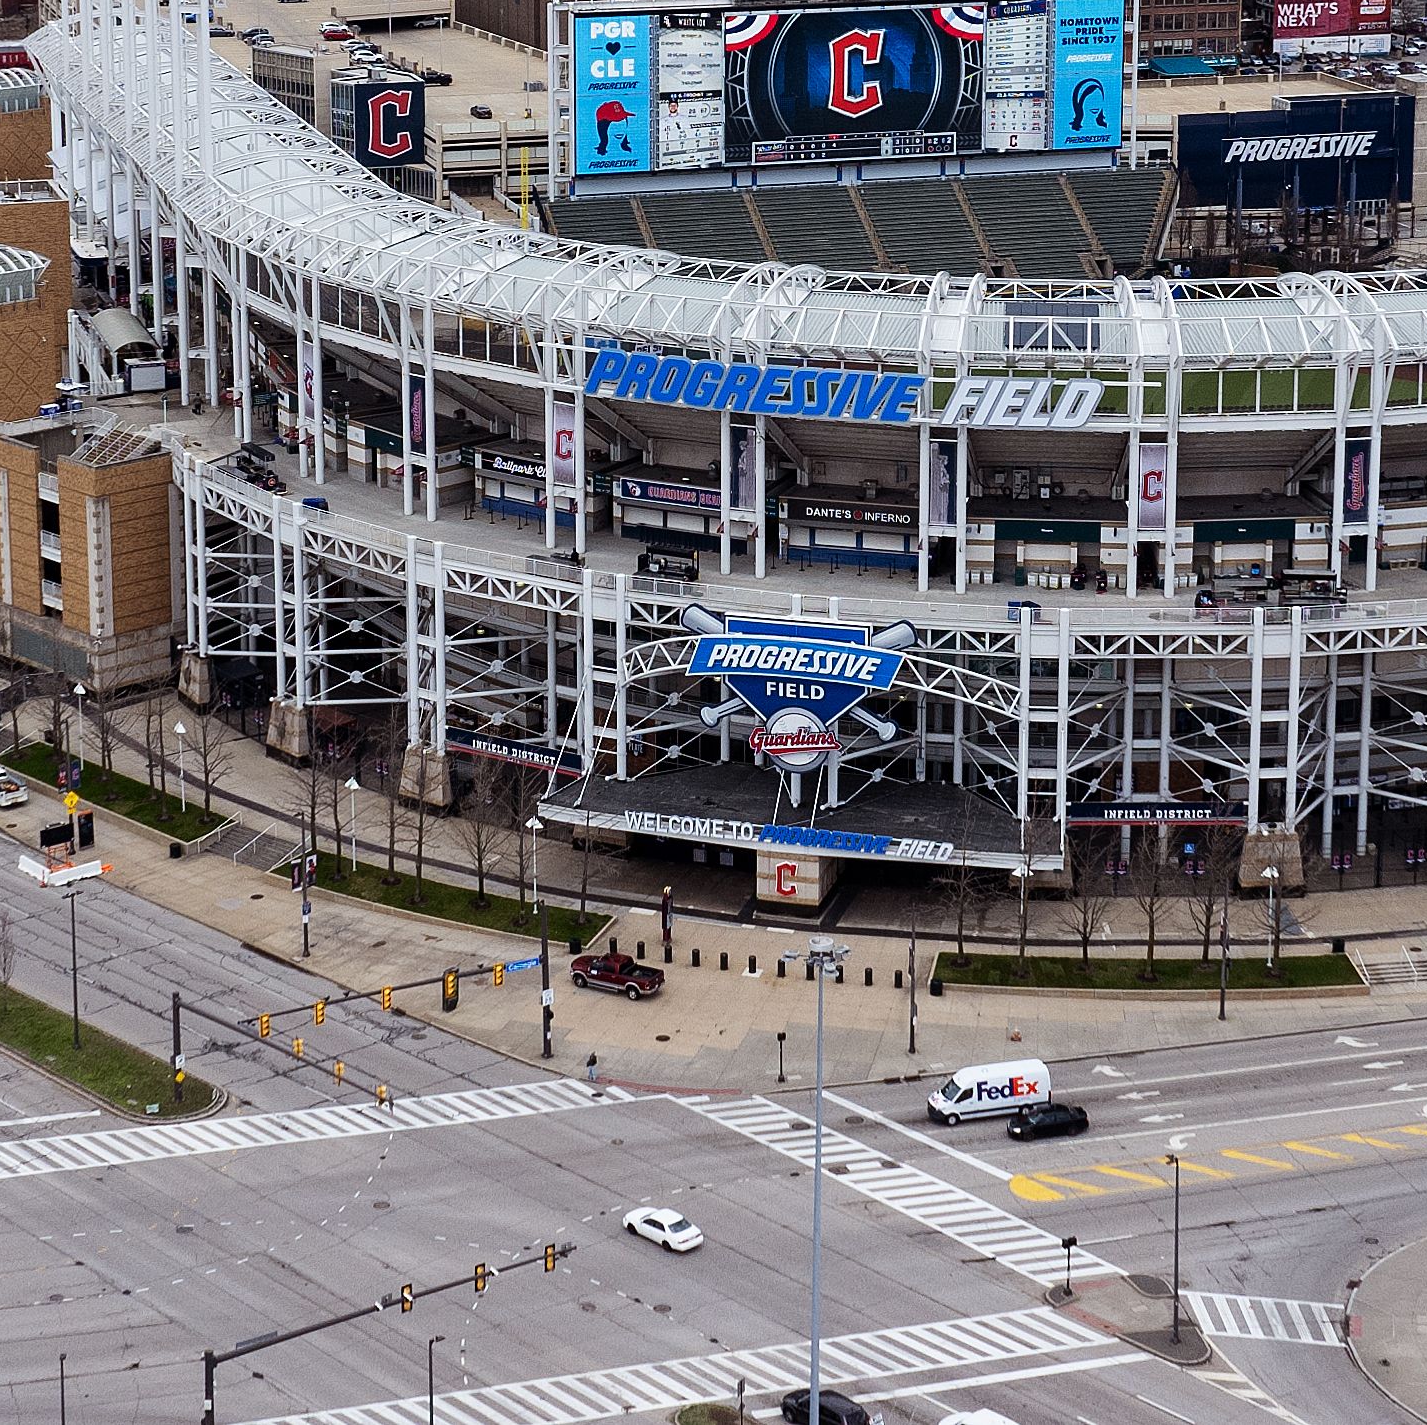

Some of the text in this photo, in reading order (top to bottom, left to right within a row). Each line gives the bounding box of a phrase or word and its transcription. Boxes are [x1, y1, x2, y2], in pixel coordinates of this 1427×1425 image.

[1277, 2, 1338, 16] WHAT'S
[590, 20, 636, 39] PGR
[1060, 17, 1119, 27] HOMETOWN
[1277, 14, 1318, 28] NEXT
[1061, 36, 1117, 46] SINCE 1937
[1075, 27, 1105, 36] PRIDE
[590, 58, 635, 78] CLE
[828, 28, 885, 119] C
[588, 80, 639, 91] PROGRESSIVE
[368, 90, 412, 158] C
[1065, 134, 1112, 144] PROGRESSIVE
[1224, 134, 1376, 163] PROGRESSIVE
[588, 159, 639, 169] PROGRESSIVE
[582, 348, 1106, 430] PROGRESSIVE FIELD
[556, 429, 574, 461] C
[493, 456, 535, 475] Ballpark
[1140, 470, 1164, 503] C
[806, 507, 911, 524] DANTE'S INFERNO
[706, 644, 882, 681] PROGRESSIVE
[766, 682, 825, 700] FIELD
[749, 727, 842, 757] Guardians
[472, 739, 556, 766] INFIELD DISTRICT
[1104, 809, 1212, 819] INFIELD DISTRICT
[624, 810, 955, 862] WELCOME TO PROGRESSIVE FIELD
[775, 861, 798, 897] C
[976, 1076, 1039, 1102] FedEx
